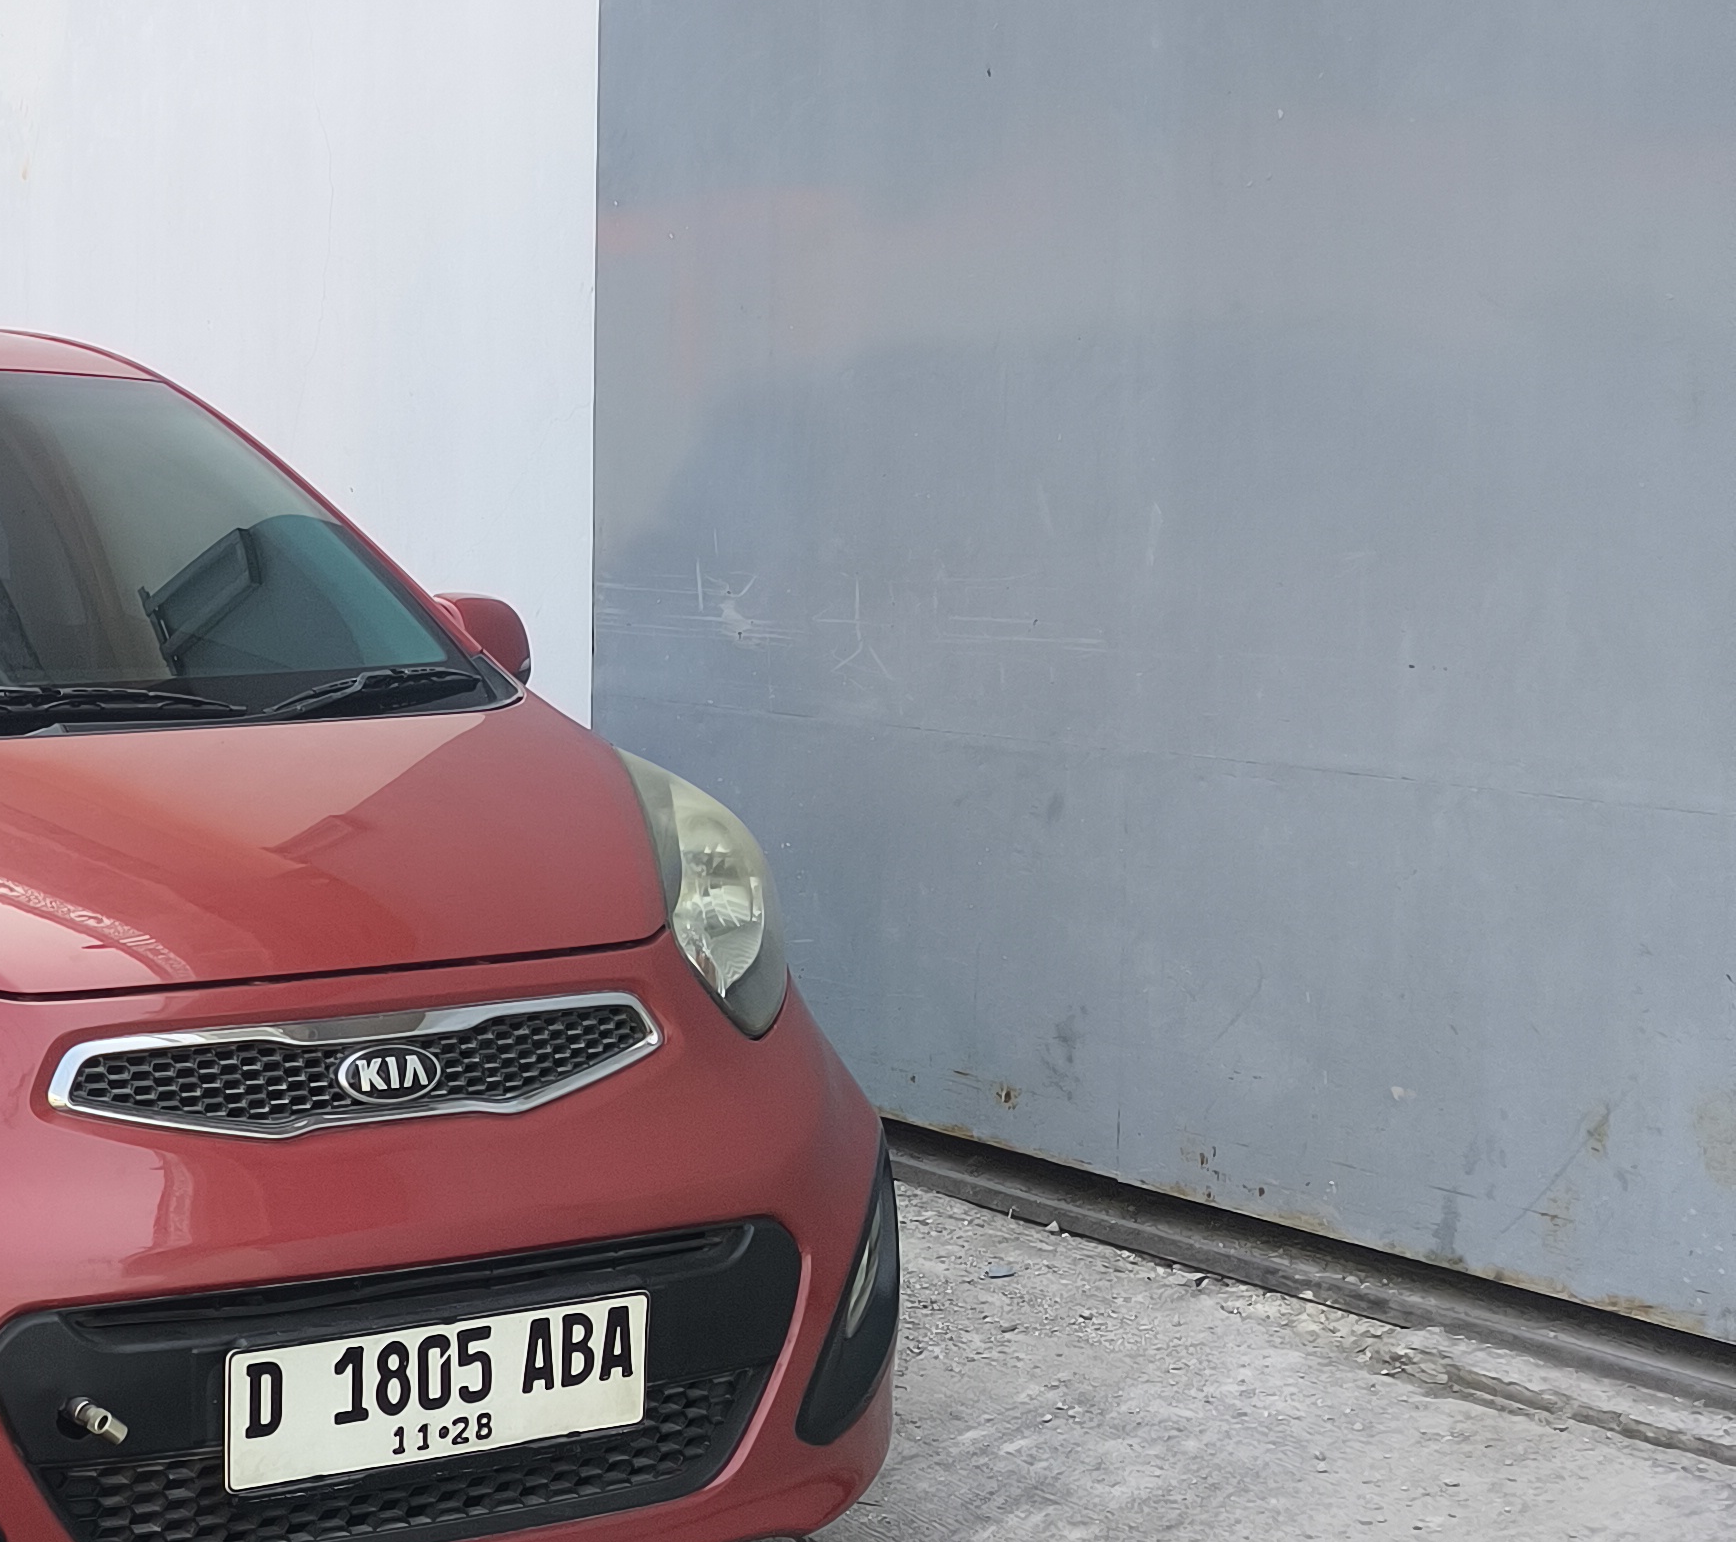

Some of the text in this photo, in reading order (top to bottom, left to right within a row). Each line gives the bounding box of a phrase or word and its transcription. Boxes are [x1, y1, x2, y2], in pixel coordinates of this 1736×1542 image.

[355, 1054, 429, 1092] KIA
[245, 1305, 634, 1440] D 1805 ABA
